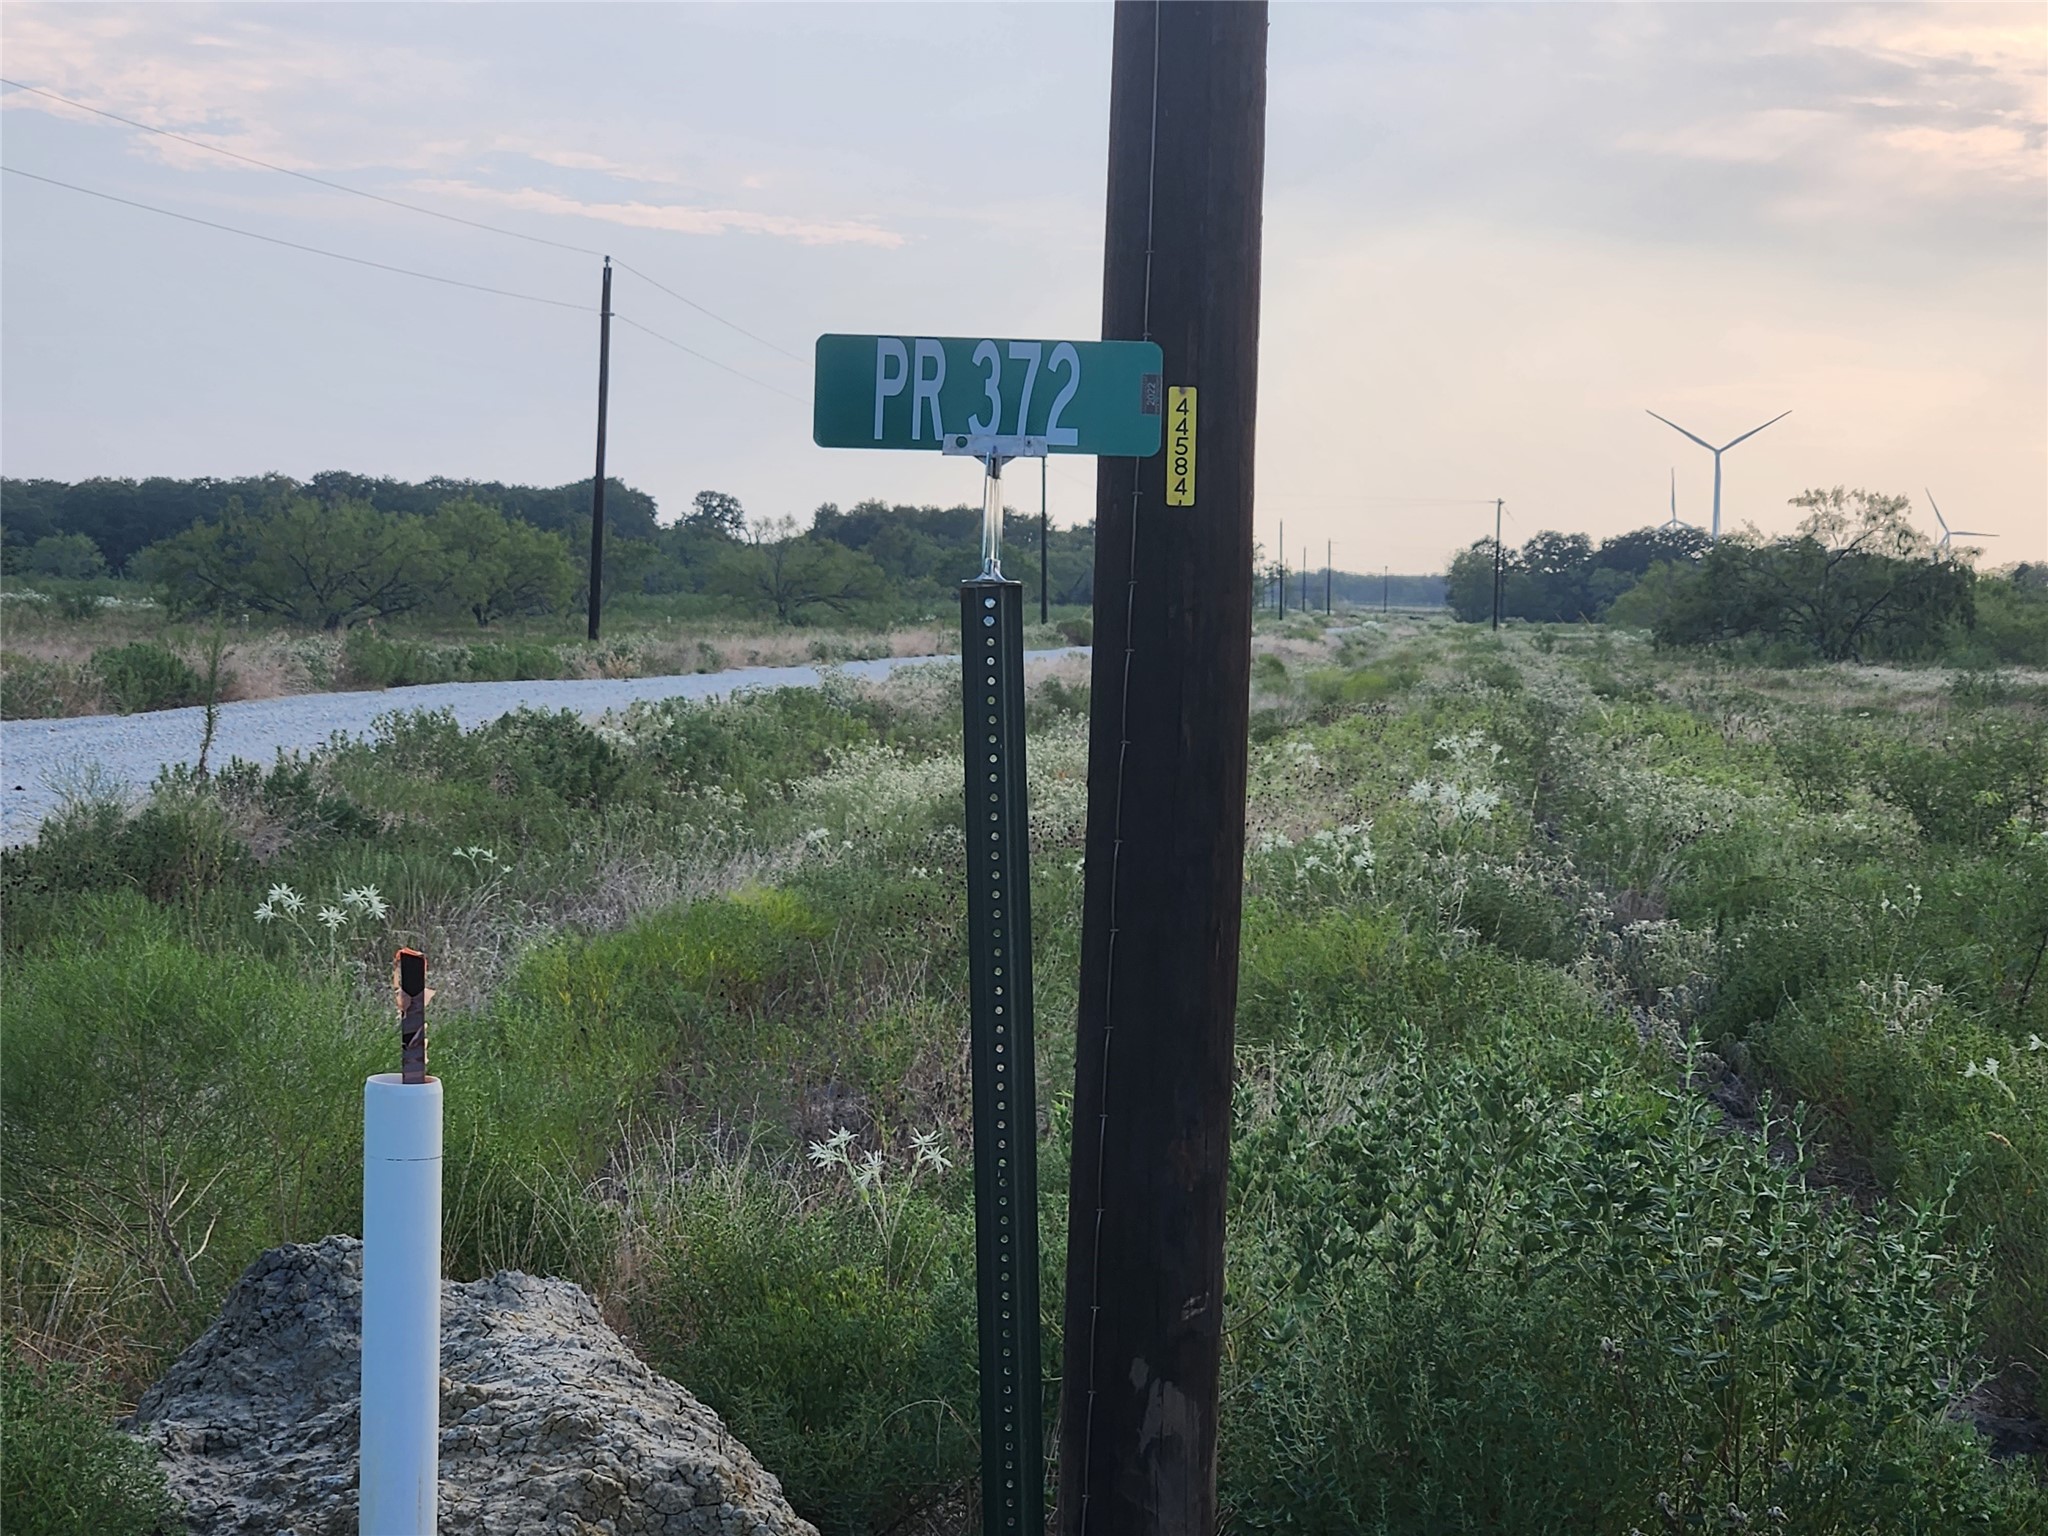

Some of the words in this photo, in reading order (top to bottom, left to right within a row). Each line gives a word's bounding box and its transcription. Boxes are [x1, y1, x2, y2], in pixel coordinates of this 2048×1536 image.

[874, 337, 946, 440] PR
[968, 339, 1080, 446] 372
[1146, 382, 1156, 406] 2022
[1174, 398, 1189, 495] 44584
